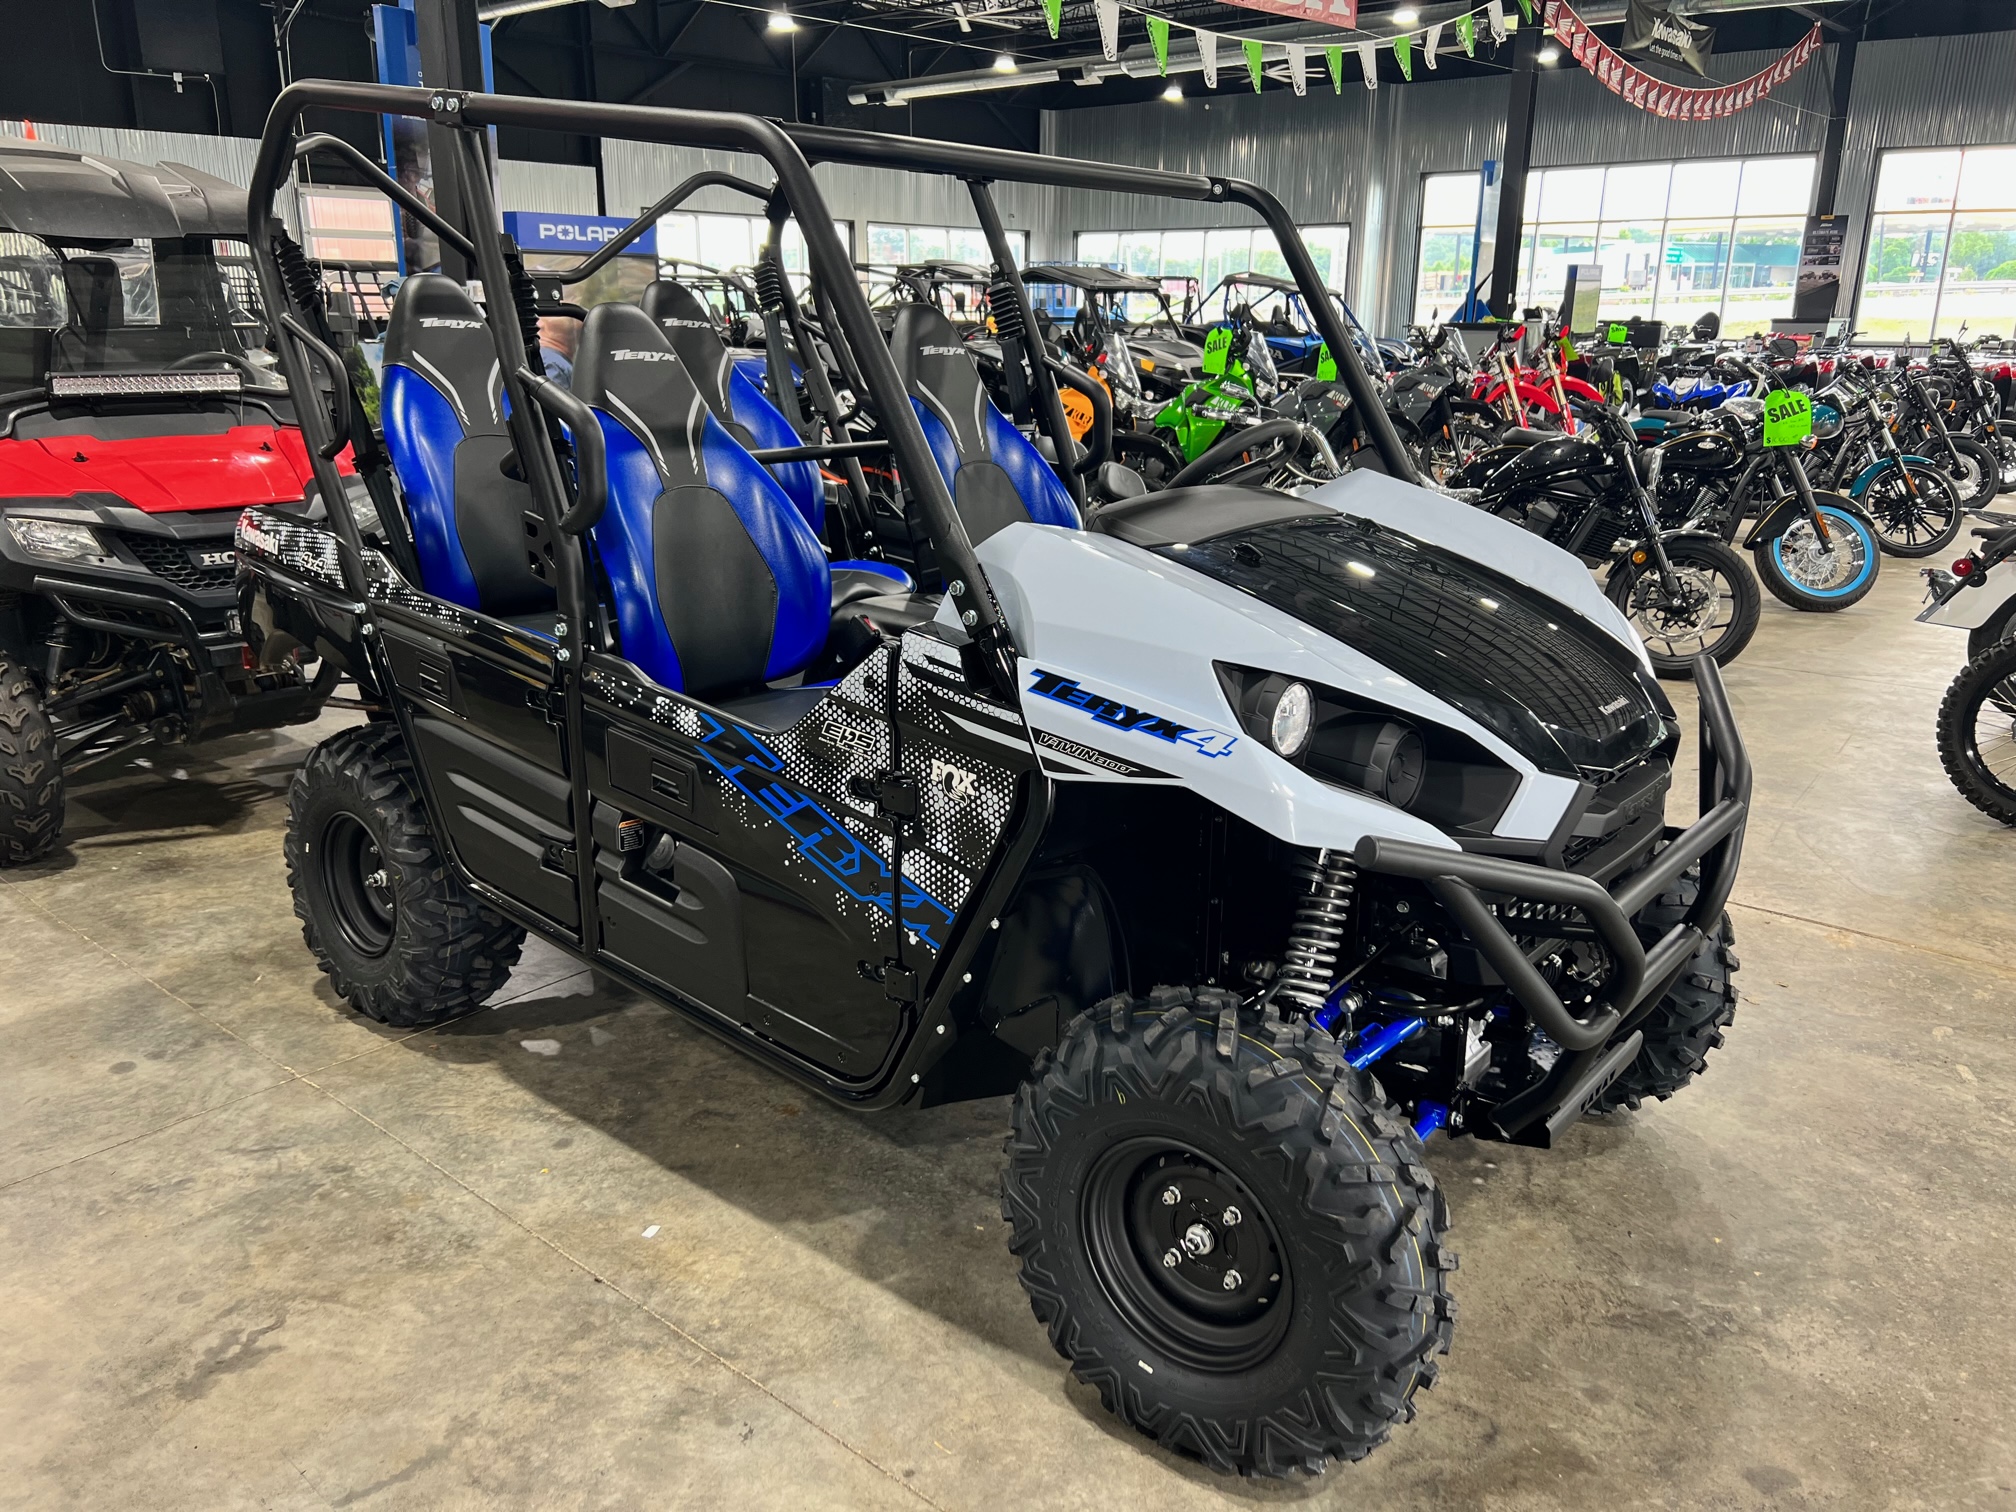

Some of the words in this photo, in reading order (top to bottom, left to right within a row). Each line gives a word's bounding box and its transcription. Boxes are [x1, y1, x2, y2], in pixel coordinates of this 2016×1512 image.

[1651, 17, 1692, 49] Kawasaki
[539, 223, 640, 243] POLAR
[1207, 337, 1227, 354] SALE
[1320, 350, 1333, 364] SA
[1767, 399, 1808, 424] SALE
[240, 518, 279, 555] Kawasaki
[300, 552, 328, 574] 4x4
[821, 720, 876, 751] EPS
[931, 758, 977, 803] FOX
